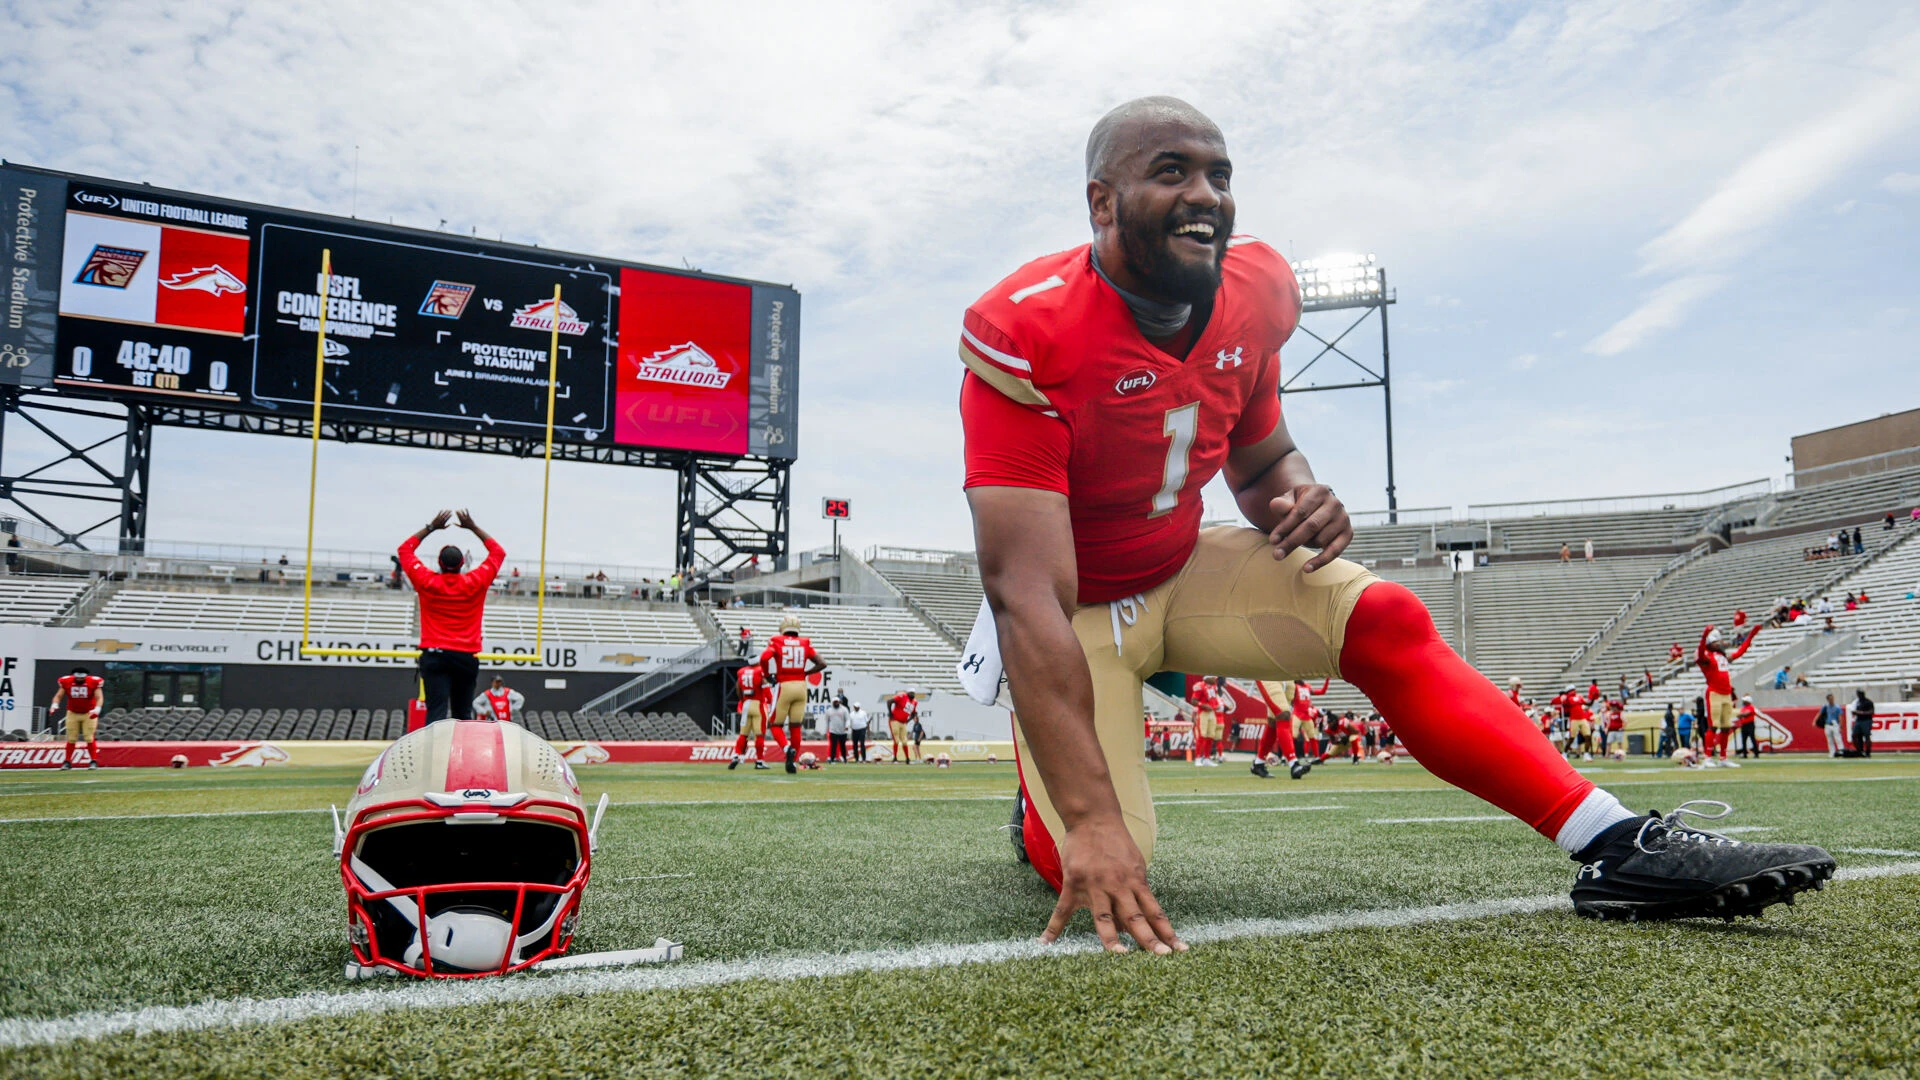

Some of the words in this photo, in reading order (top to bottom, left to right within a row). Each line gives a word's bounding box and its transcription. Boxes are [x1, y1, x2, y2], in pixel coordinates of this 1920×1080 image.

[14, 187, 37, 261] Protective
[121, 198, 159, 216] UNITED
[161, 204, 209, 224] FOOTBALL
[211, 211, 248, 230] LEAGUE
[9, 267, 31, 329] Stadium
[316, 272, 362, 300] USFL
[1009, 275, 1066, 304] 1
[514, 316, 588, 334] STALLONS
[770, 301, 784, 361] Protective
[72, 346, 93, 376] 0
[116, 340, 191, 375] 48:40
[461, 341, 547, 363] PROTECTIVE
[474, 355, 535, 372] STADIUM
[132, 370, 153, 387] 1ST
[155, 373, 180, 389] QTR
[209, 361, 228, 390] 0
[444, 369, 466, 378] JUNE
[640, 366, 728, 387] STALLIONS
[1123, 376, 1150, 390] UFL
[769, 364, 783, 414] Stadium
[648, 404, 720, 428] UFL
[1147, 400, 1200, 520] 1
[827, 500, 848, 517] 25
[150, 644, 229, 653] CHEVROLET
[782, 646, 804, 668] 20
[1852, 712, 1919, 730] SPN
